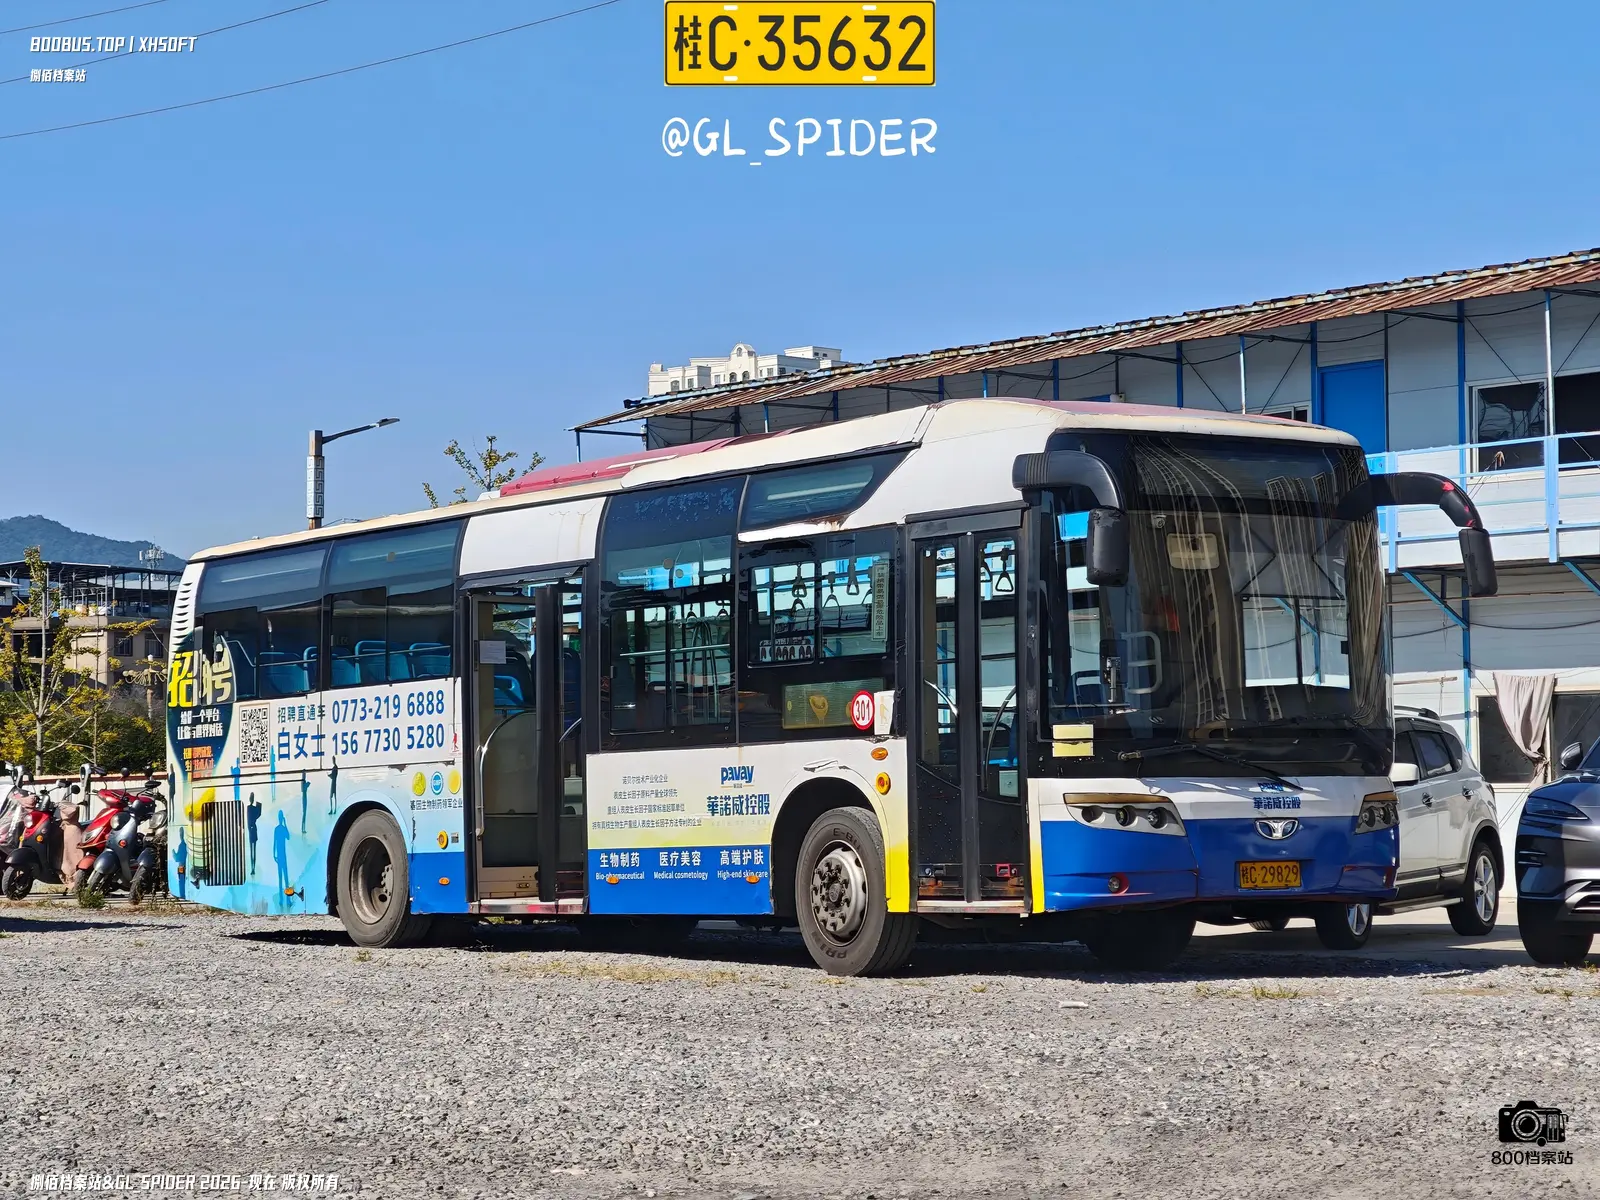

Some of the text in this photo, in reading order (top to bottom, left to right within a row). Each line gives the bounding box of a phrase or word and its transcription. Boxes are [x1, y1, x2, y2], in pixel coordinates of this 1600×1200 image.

[277, 690, 445, 724] 招聘直通车 0773-219 6888
[855, 700, 871, 722] 301
[277, 723, 445, 762] 白女士 156 7730 5280
[720, 765, 755, 785] pavay
[600, 852, 640, 868] 生物制药
[659, 850, 701, 867] 医疗美容
[720, 848, 764, 866] 高端护肤
[653, 870, 709, 881] Medical cosmetology
[717, 869, 742, 881] High-end
[755, 870, 769, 878] care
